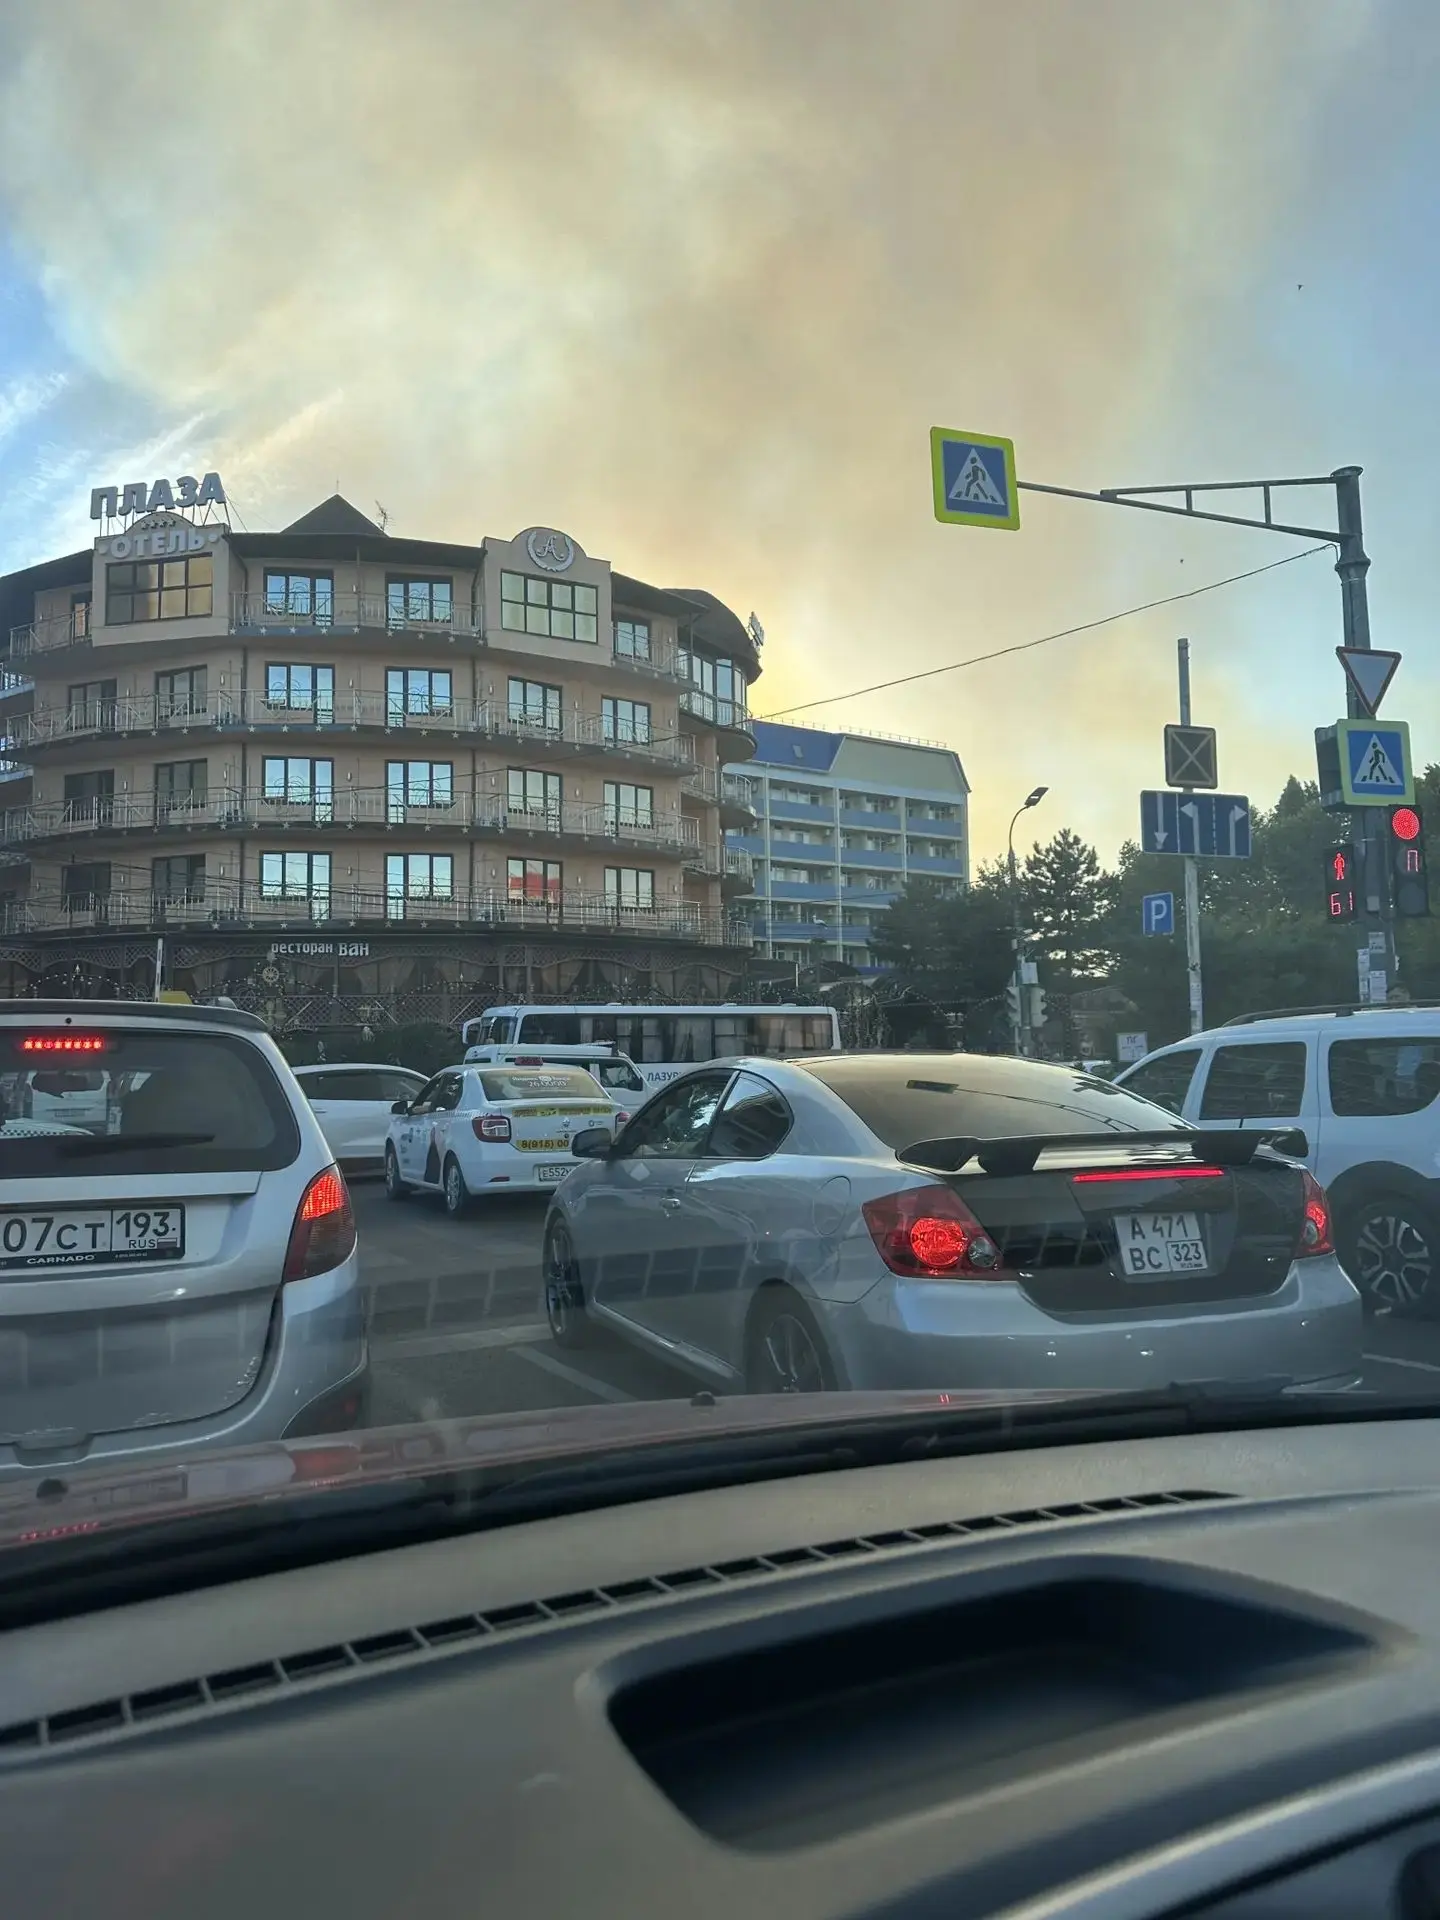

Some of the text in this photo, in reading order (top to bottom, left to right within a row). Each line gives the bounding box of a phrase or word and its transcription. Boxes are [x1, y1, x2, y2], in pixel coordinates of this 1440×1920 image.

[90, 472, 227, 519] ПЛАЗА
[110, 528, 206, 559] ОТЕЛЬ
[1151, 900, 1168, 931] P
[647, 1071, 682, 1081] ЛАЗУР
[3, 1217, 105, 1253] 07СТ
[115, 1211, 171, 1238] 193
[1130, 1214, 1189, 1240] А 471
[128, 1239, 156, 1249] RUS
[1171, 1243, 1201, 1261] 323
[26, 1254, 95, 1264] CARNADO
[1129, 1246, 1163, 1271] ВС
